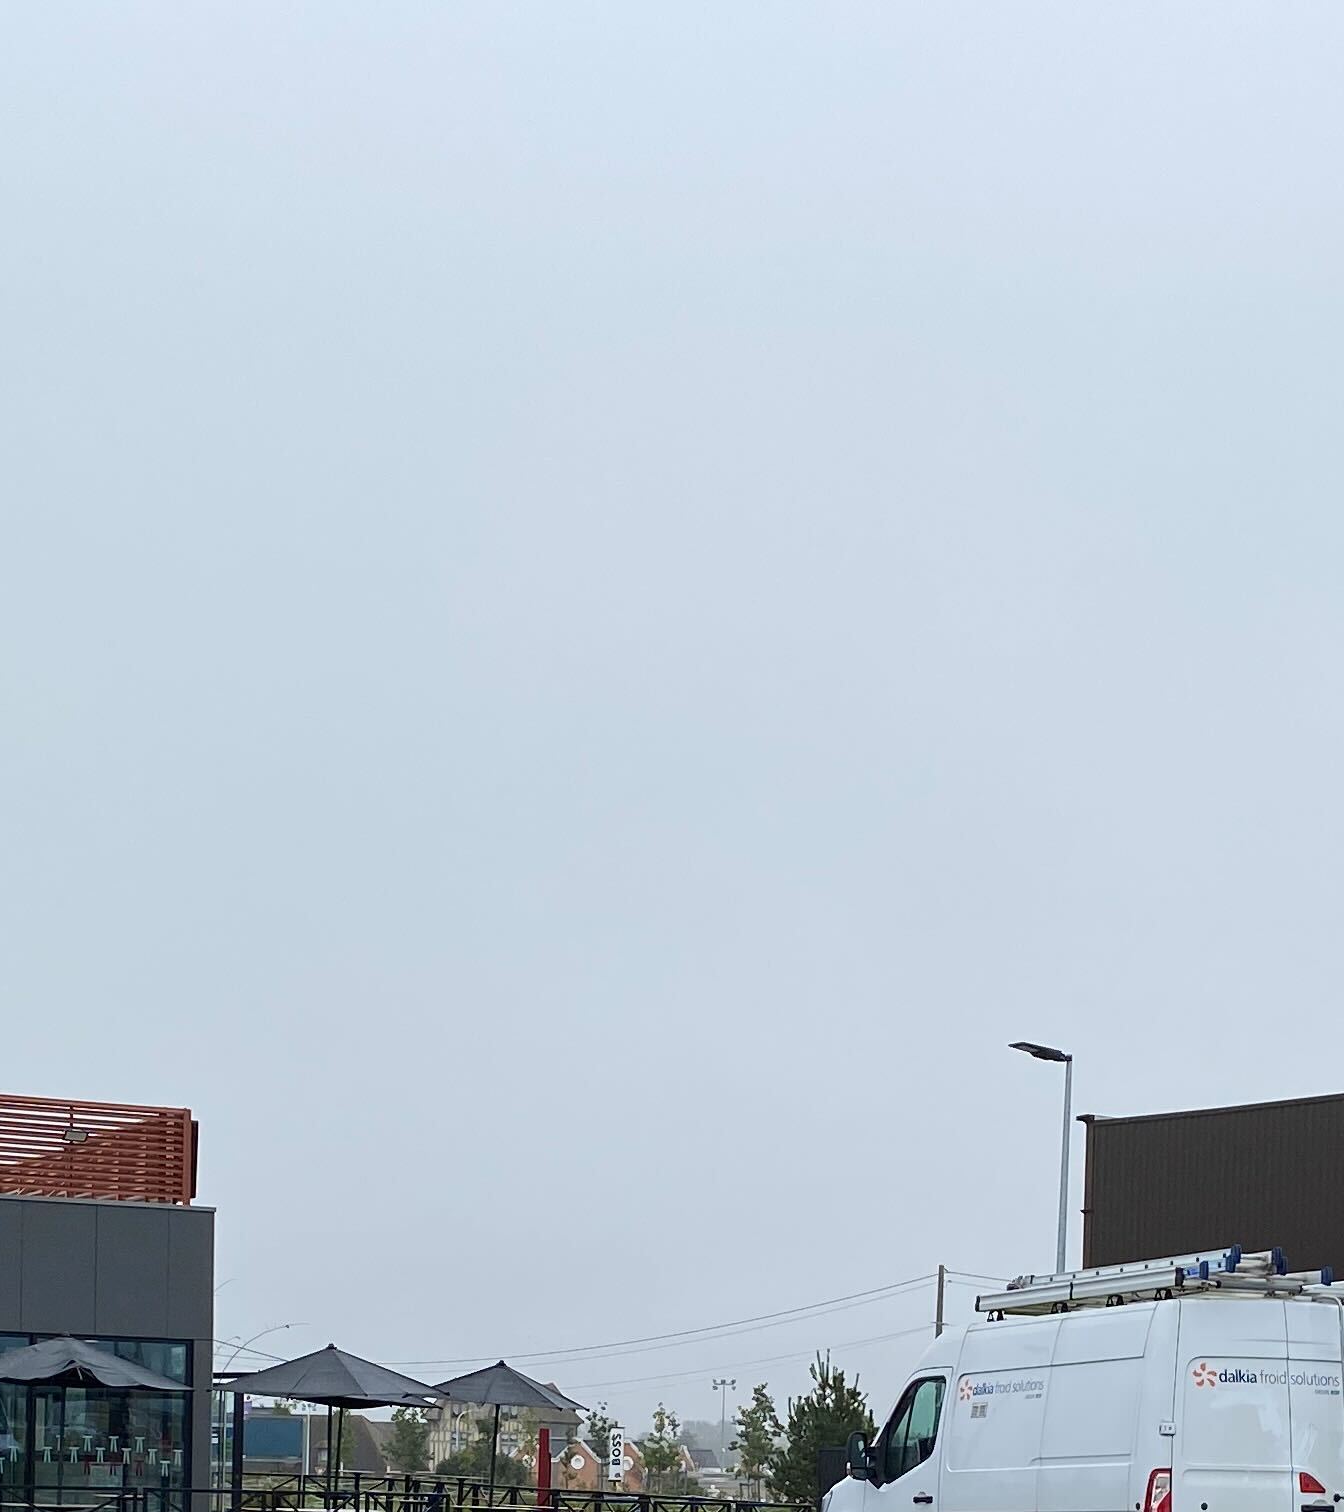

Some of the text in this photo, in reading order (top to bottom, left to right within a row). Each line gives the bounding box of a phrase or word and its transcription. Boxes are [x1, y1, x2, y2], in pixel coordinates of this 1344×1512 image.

[1219, 1368, 1340, 1387] dalkia froid solutions
